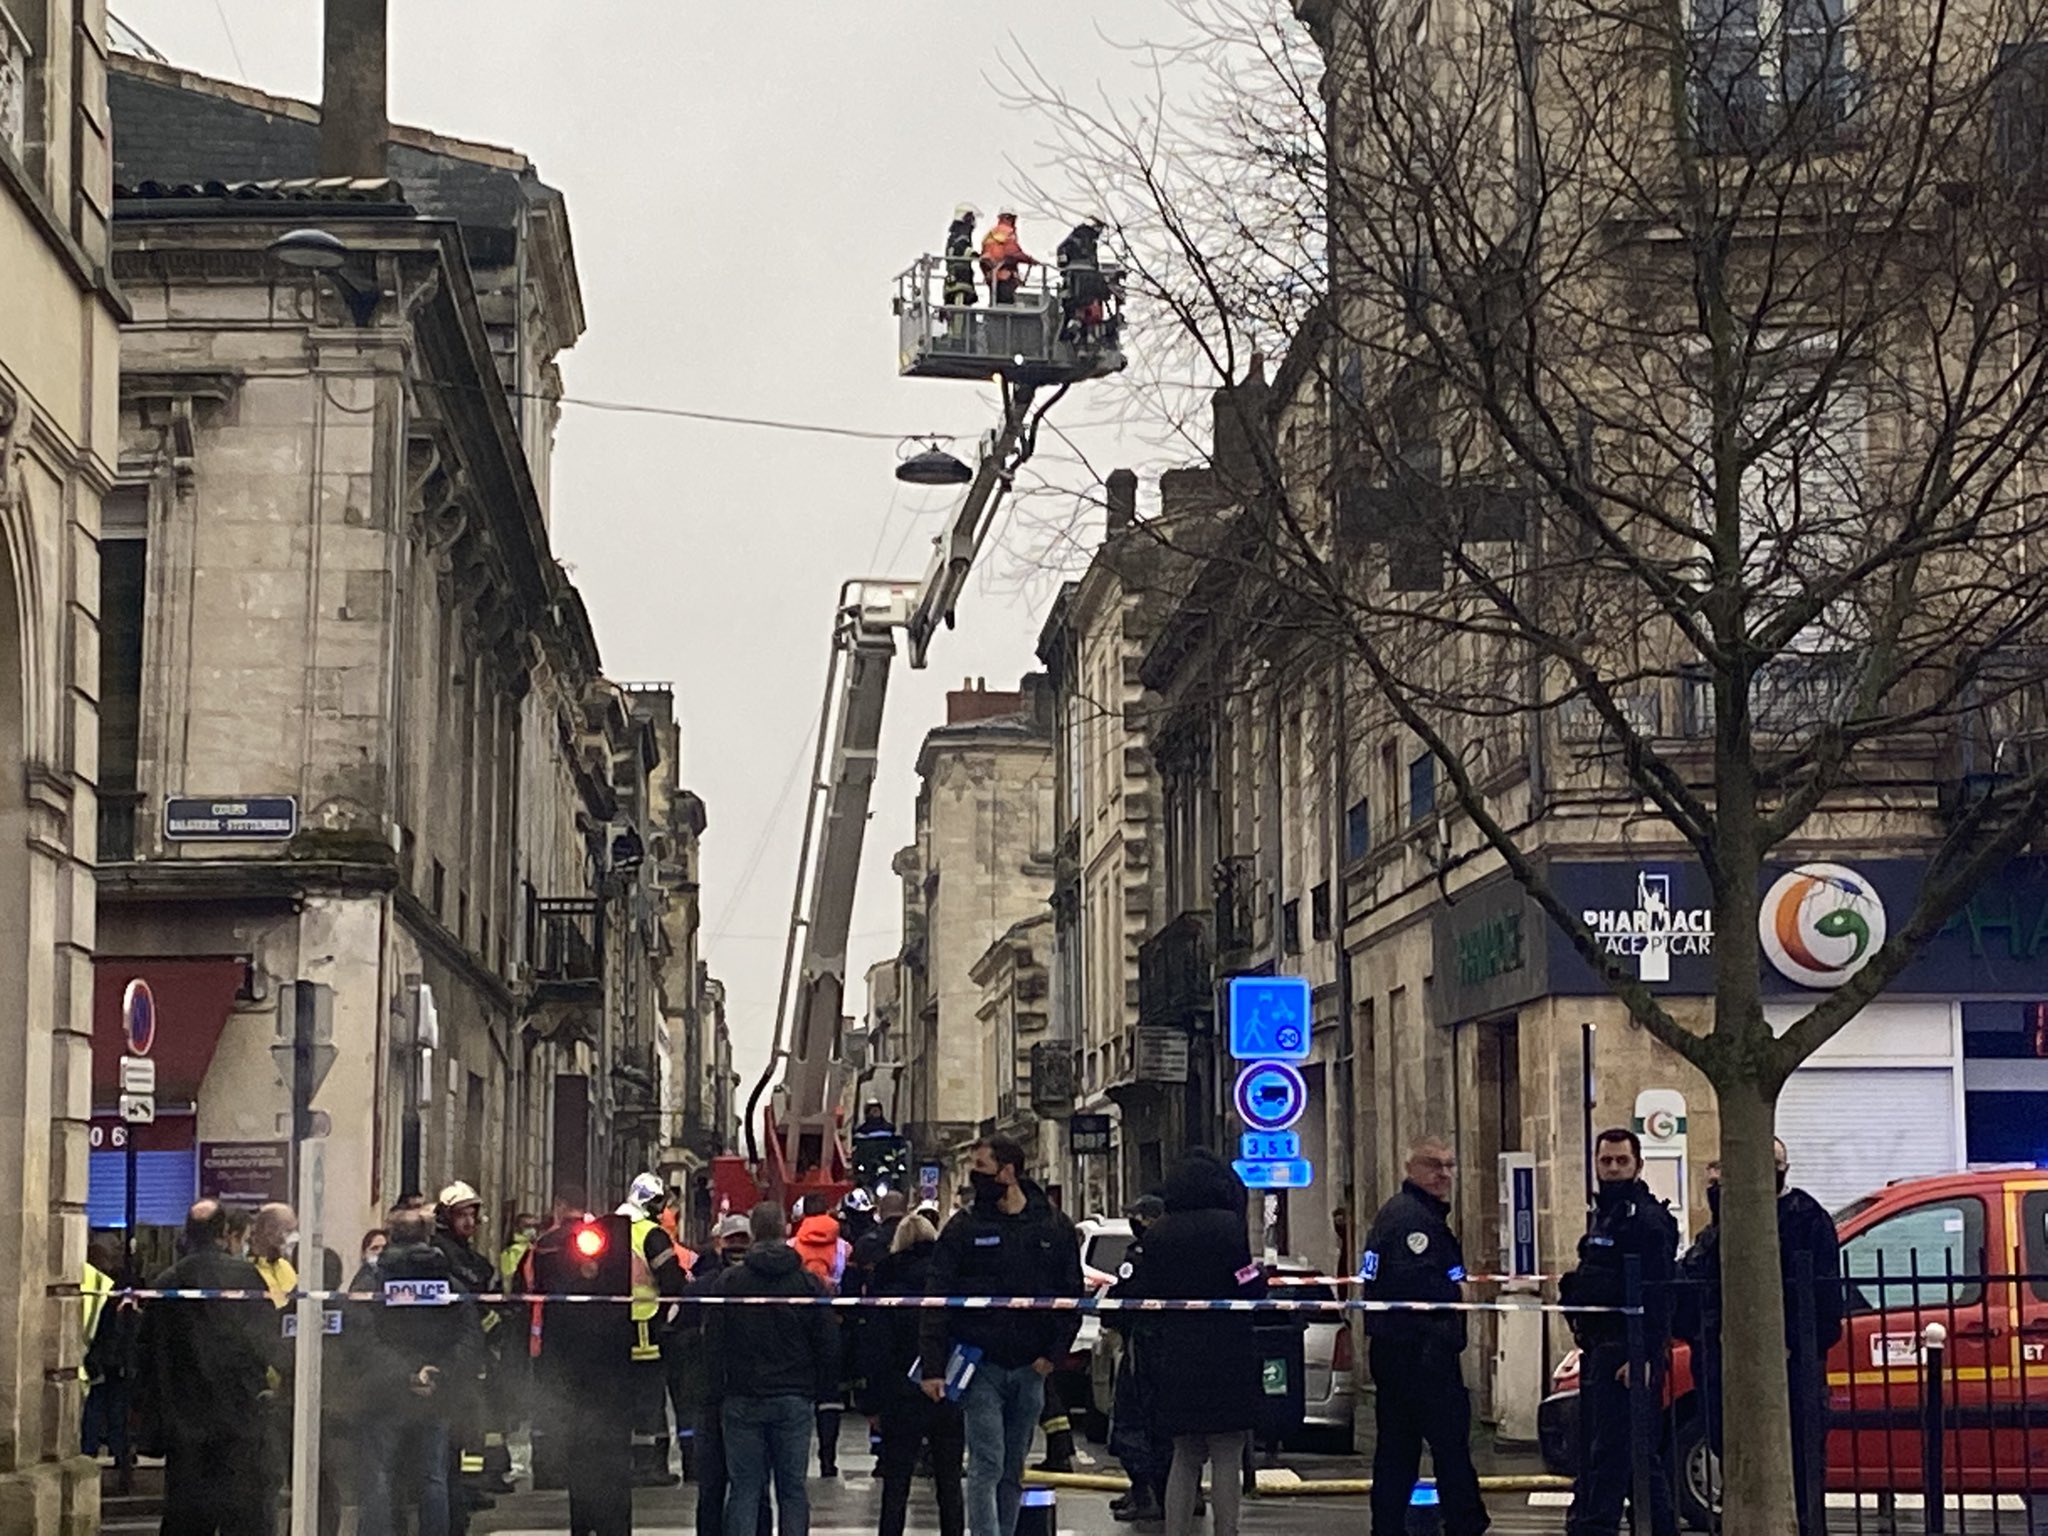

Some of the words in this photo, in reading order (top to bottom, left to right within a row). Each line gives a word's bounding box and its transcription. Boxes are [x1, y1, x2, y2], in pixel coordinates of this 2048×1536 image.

[1583, 909, 1711, 932] PHARMACI
[1603, 935, 1643, 955] ACE
[1651, 935, 1711, 955] PICAR
[388, 1283, 446, 1301] POLICE
